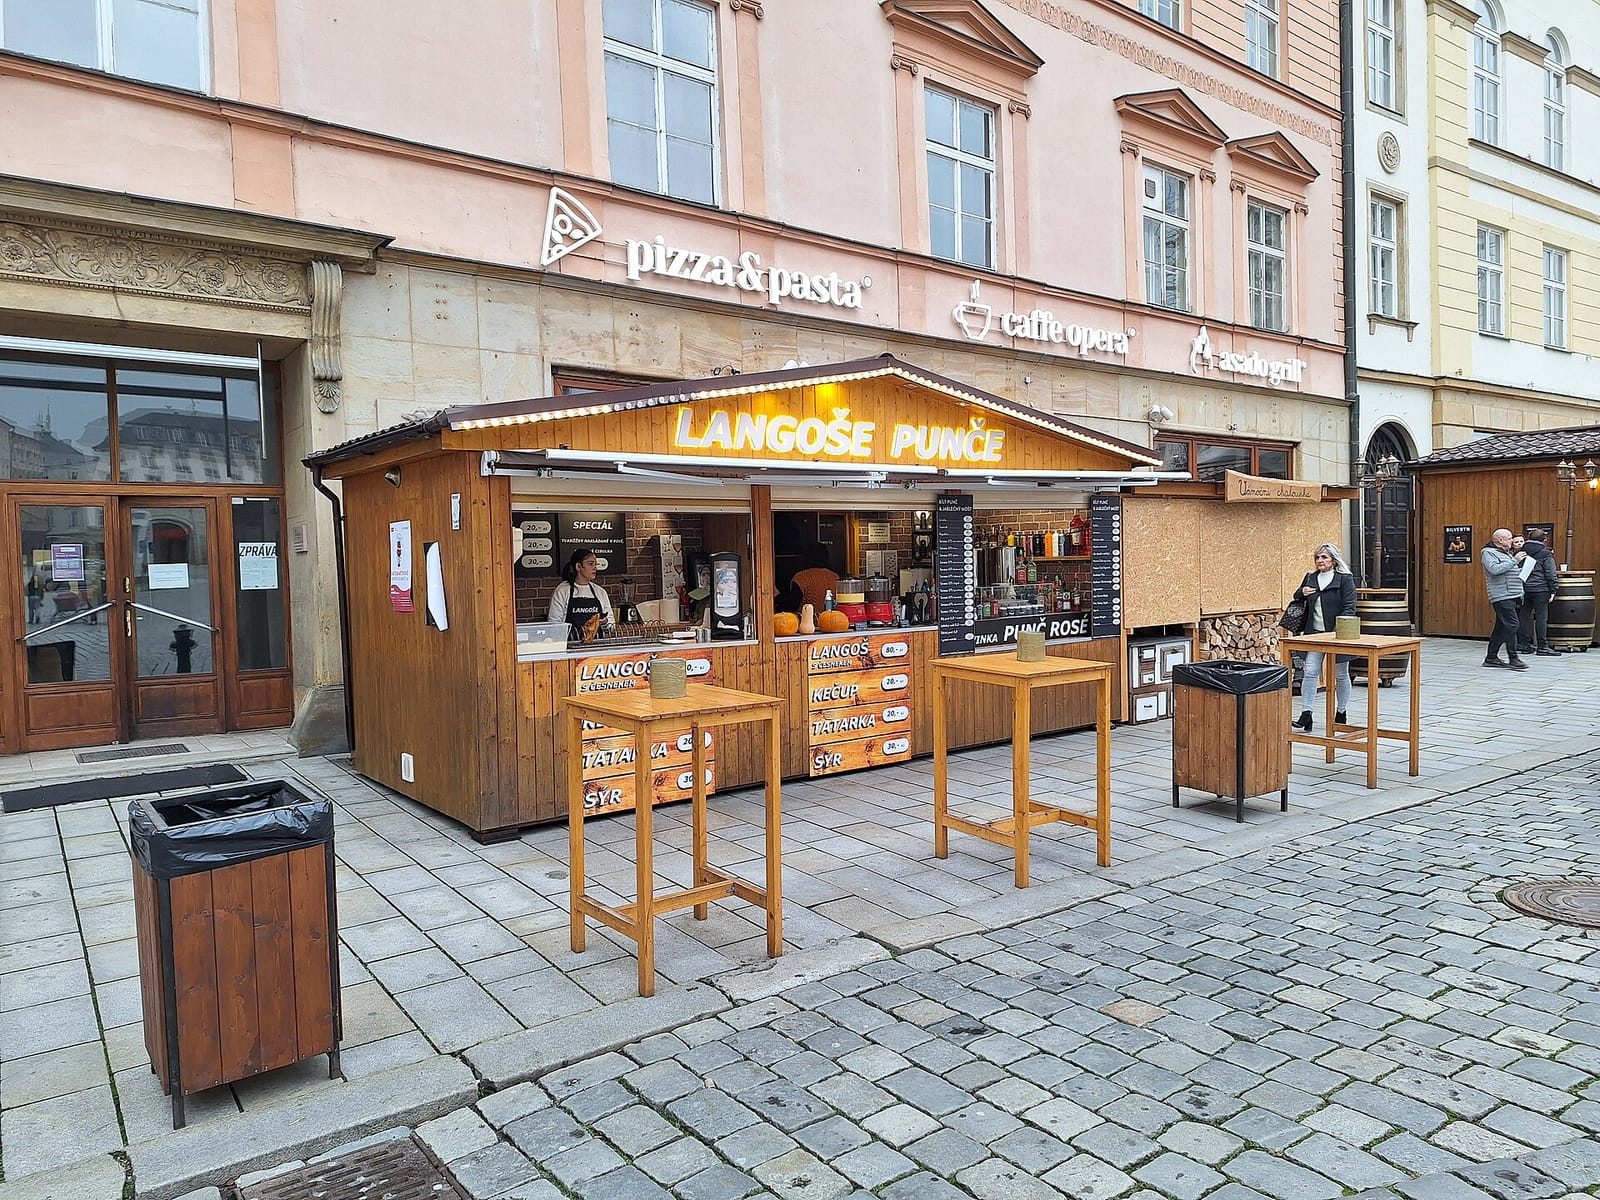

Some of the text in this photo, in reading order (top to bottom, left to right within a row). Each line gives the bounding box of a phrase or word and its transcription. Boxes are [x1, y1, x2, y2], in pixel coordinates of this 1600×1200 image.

[625, 234, 864, 309] pizza&pasta
[1001, 309, 1130, 356] caffe opera
[1218, 350, 1303, 386] asado grill
[675, 408, 1006, 463] LANGOŠE PUNČE
[572, 519, 614, 530] SPECIÁL
[239, 544, 279, 557] ZPRÁVA
[1050, 614, 1089, 637] ROSÉ
[811, 637, 870, 660] LANGOŠ
[580, 679, 637, 692] S ČESNEKEM
[812, 682, 860, 703] KEČUP
[812, 713, 876, 736] TATARKA
[813, 749, 842, 771] SÝR
[583, 784, 623, 810] SÝR
